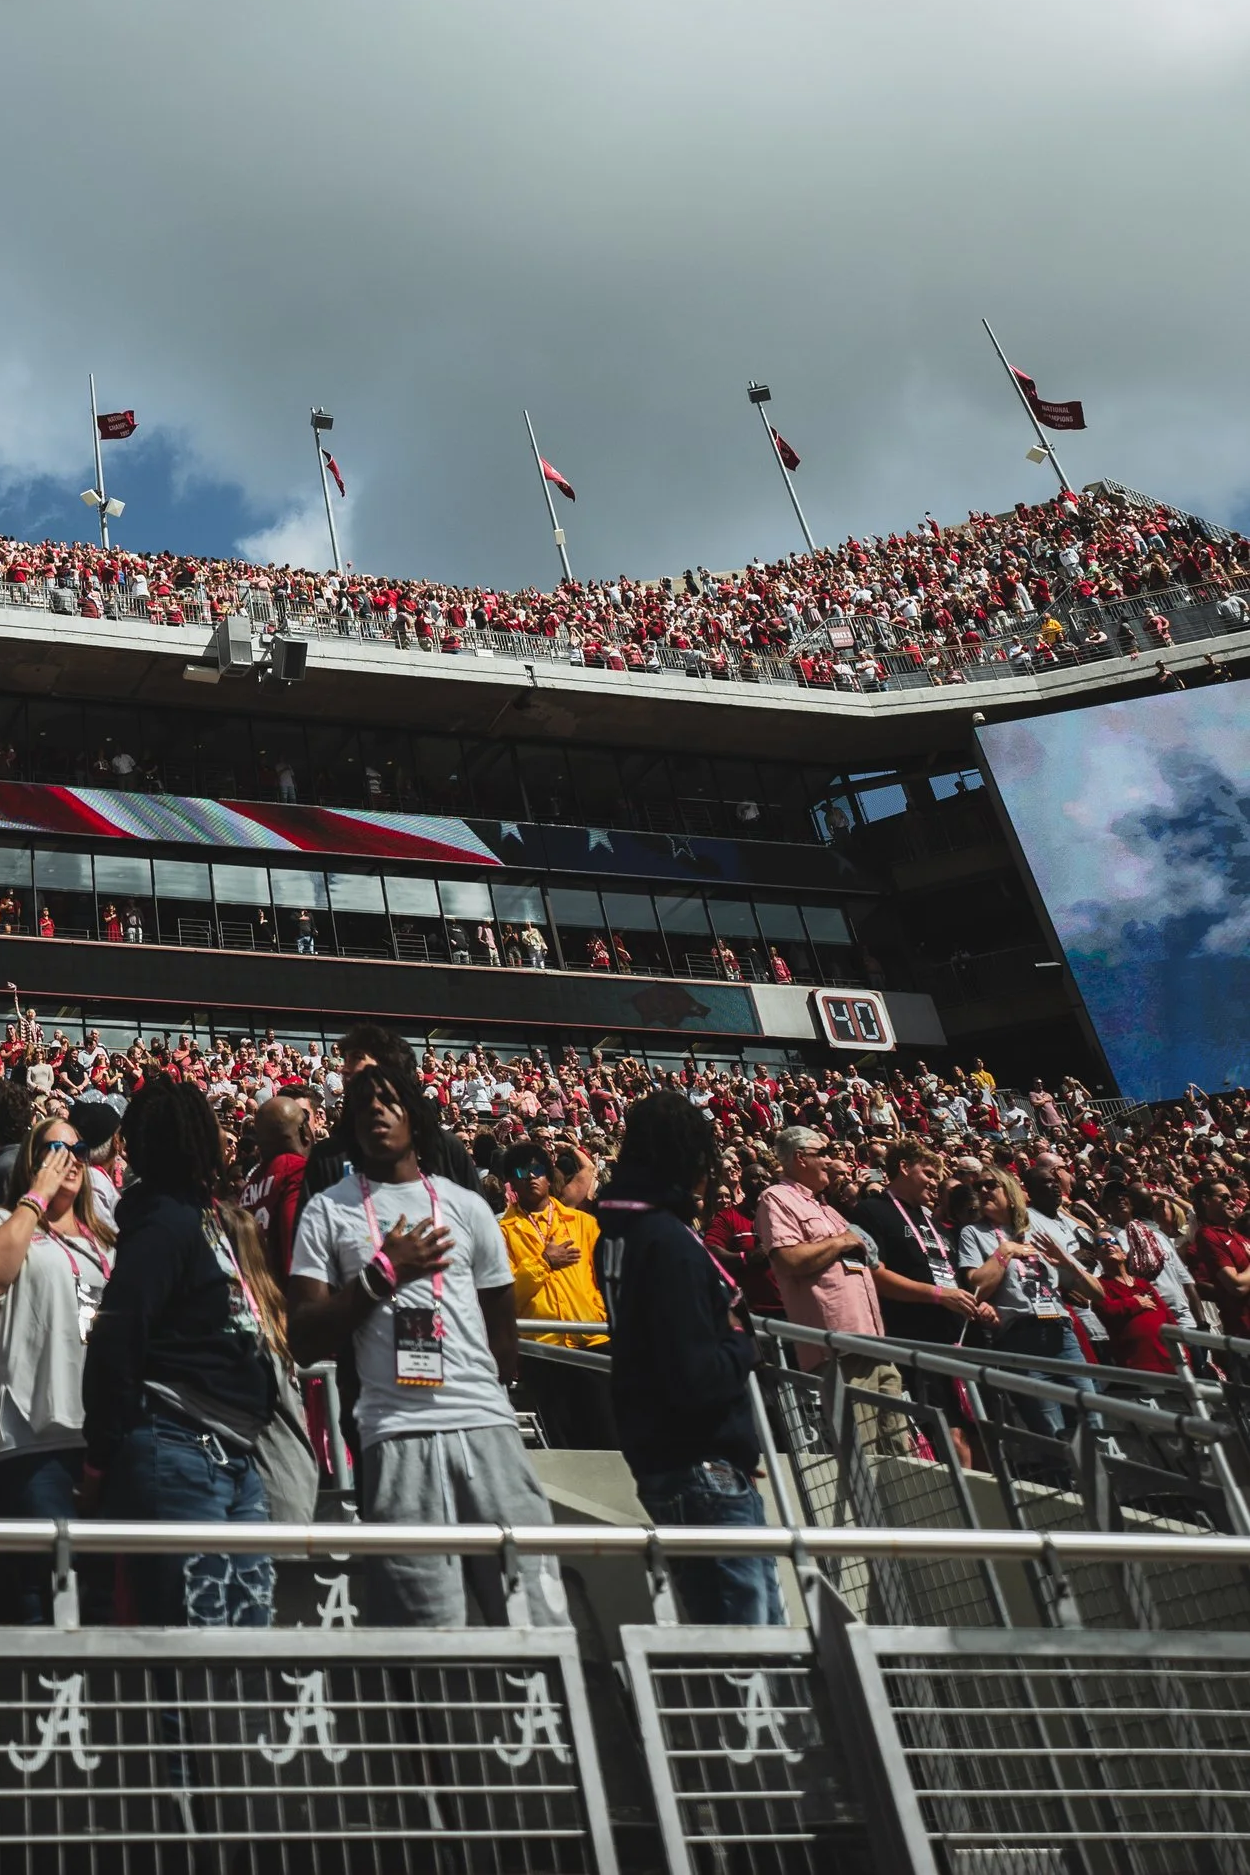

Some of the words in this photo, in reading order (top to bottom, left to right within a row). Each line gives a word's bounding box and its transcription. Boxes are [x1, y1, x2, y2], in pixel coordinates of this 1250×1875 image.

[1041, 405, 1070, 413] NATIONAL
[828, 1001, 881, 1040] 40
[313, 1572, 360, 1629] A
[7, 1672, 101, 1772] A
[257, 1670, 349, 1765] A
[493, 1671, 575, 1767] A
[718, 1670, 804, 1765] A
